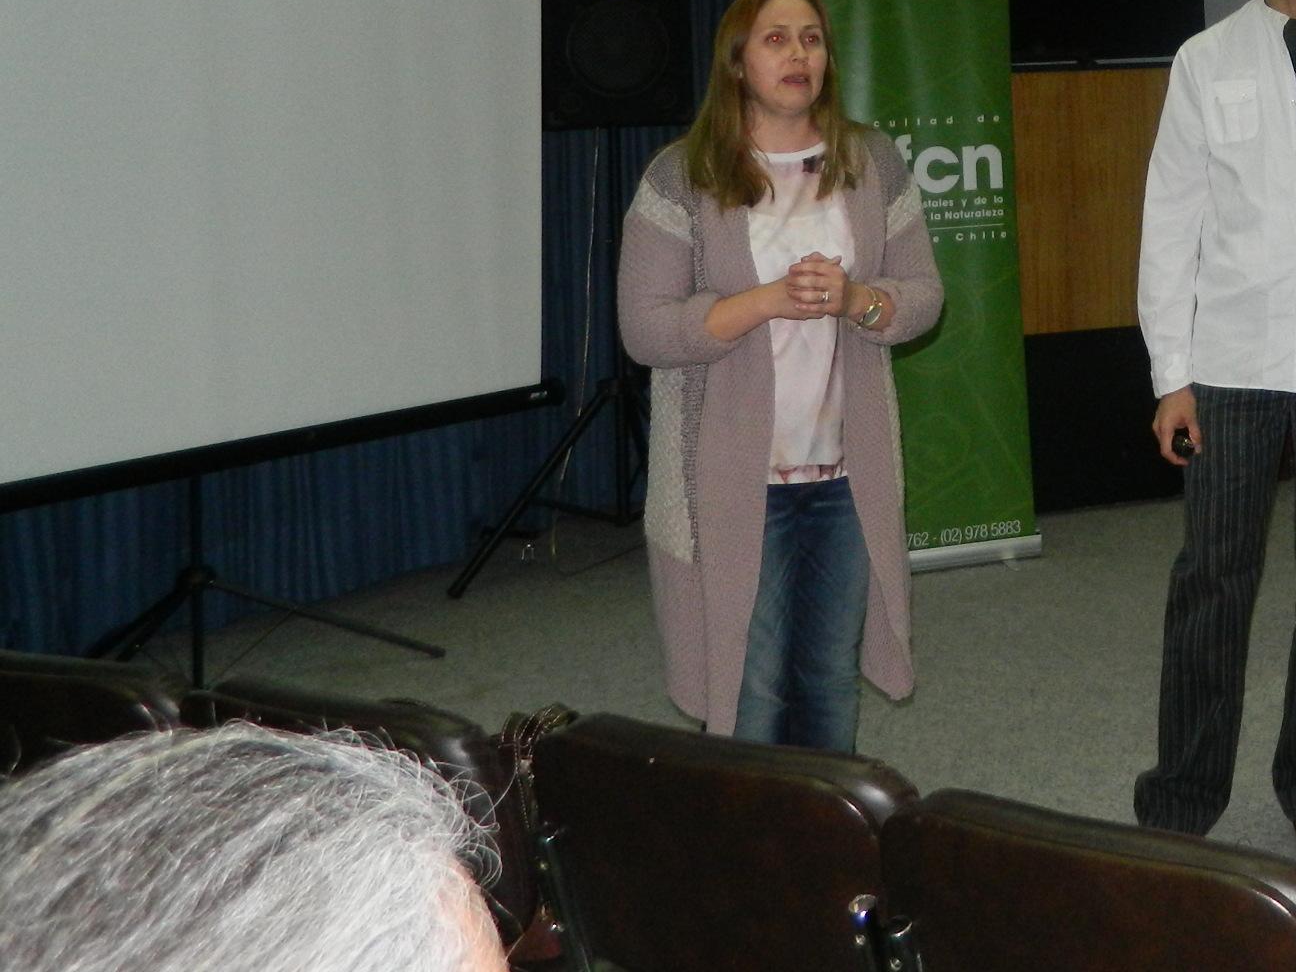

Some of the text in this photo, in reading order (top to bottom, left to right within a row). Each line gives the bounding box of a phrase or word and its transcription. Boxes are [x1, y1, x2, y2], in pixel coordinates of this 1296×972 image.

[976, 114, 1000, 123] de
[973, 194, 988, 206] de
[993, 194, 1004, 204] la
[930, 208, 1004, 221] la Naturaleza
[955, 229, 1008, 242] Chile
[940, 526, 963, 544] (02)
[966, 523, 989, 542] 978
[990, 519, 1021, 538] 5883
